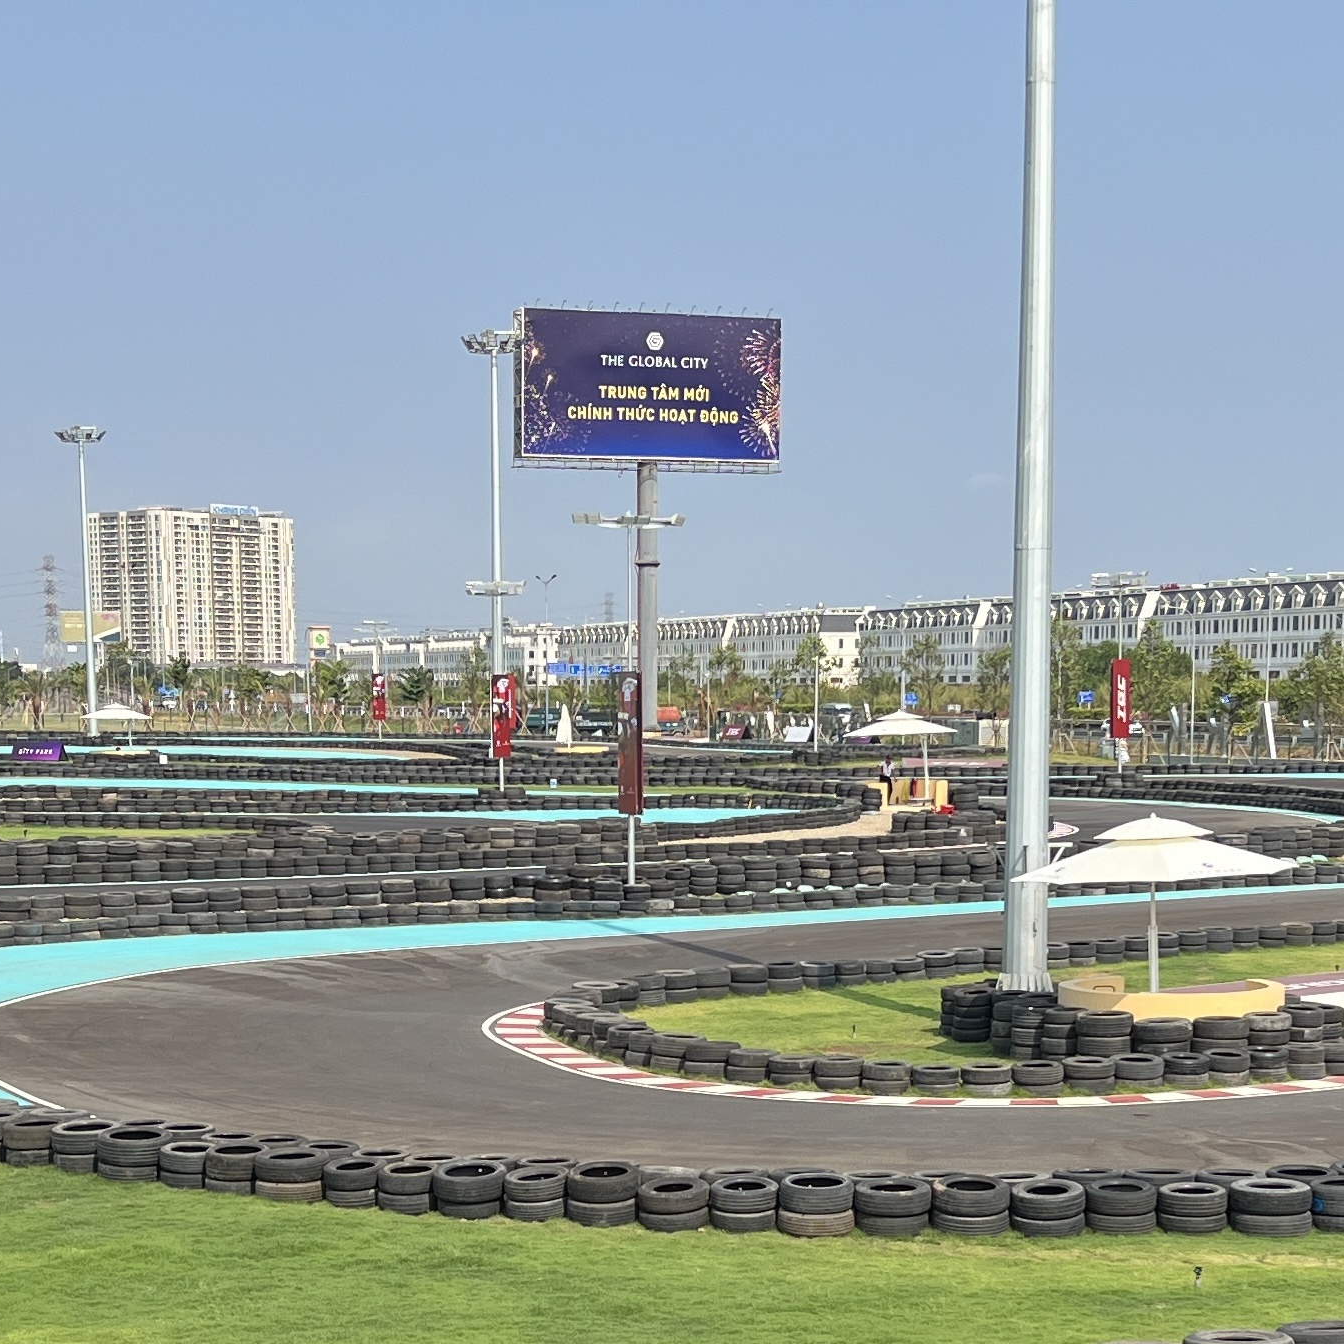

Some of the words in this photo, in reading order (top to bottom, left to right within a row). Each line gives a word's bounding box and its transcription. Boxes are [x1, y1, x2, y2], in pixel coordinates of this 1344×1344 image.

[601, 354, 624, 367] THE
[628, 354, 677, 368] GLOBAL
[681, 355, 709, 369] CITY
[598, 385, 647, 400] TRUNG
[650, 382, 680, 401] TÂM
[683, 384, 710, 402] MỚI
[567, 402, 612, 420] CHÍNH
[617, 403, 655, 421] THỨC
[659, 408, 696, 425] HOẠT
[699, 408, 739, 426] ĐỘNG
